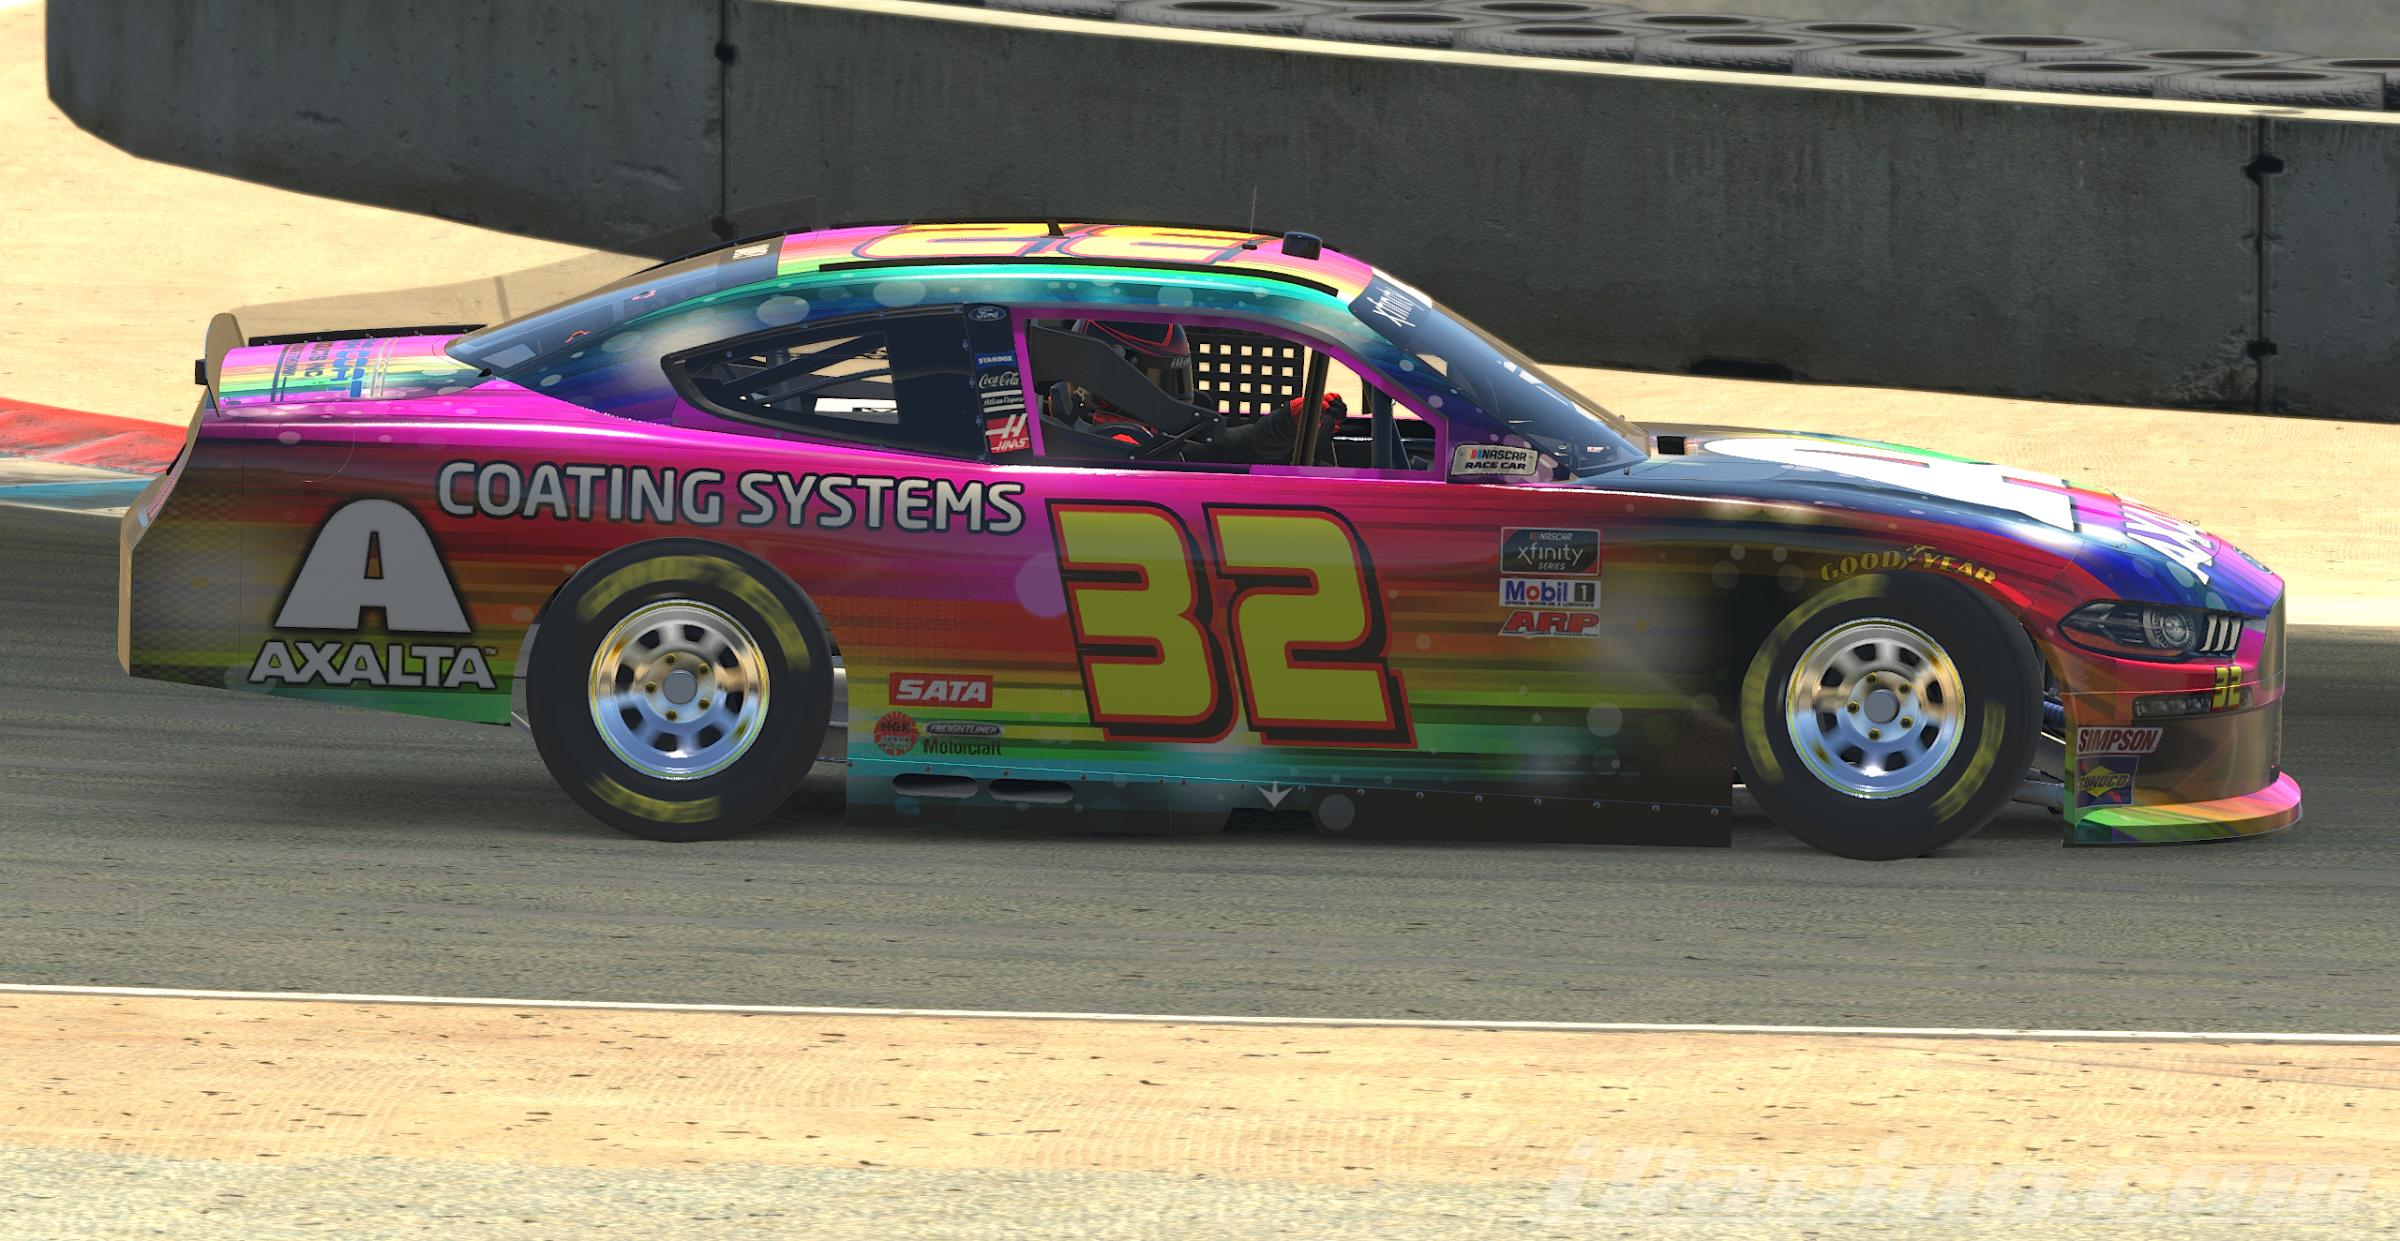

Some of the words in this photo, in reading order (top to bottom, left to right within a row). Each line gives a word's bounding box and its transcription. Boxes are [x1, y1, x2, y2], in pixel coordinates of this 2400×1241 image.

[978, 355, 1014, 364] STANDOX
[1482, 449, 1527, 461] NASCAR
[1465, 461, 1498, 469] RACE
[1501, 462, 1526, 470] CAR
[436, 460, 726, 526] COATING
[738, 471, 1026, 534] SYSTEMS
[1539, 532, 1574, 541] NASCAR
[1517, 543, 1585, 566] xfinity
[1538, 562, 1567, 571] SERIES
[1505, 580, 1569, 602] Mobil
[1044, 498, 1418, 749] 32
[1503, 611, 1600, 633] ARP
[247, 640, 496, 689] AXALTA
[895, 679, 987, 703] SATA
[2210, 665, 2243, 712] 32
[880, 721, 913, 732] NGK
[930, 724, 998, 734] FREIGHTLINER
[923, 738, 1003, 755] Motorcraft
[2078, 729, 2159, 752] SIMPSON
[2079, 774, 2130, 789] SUNOCO
